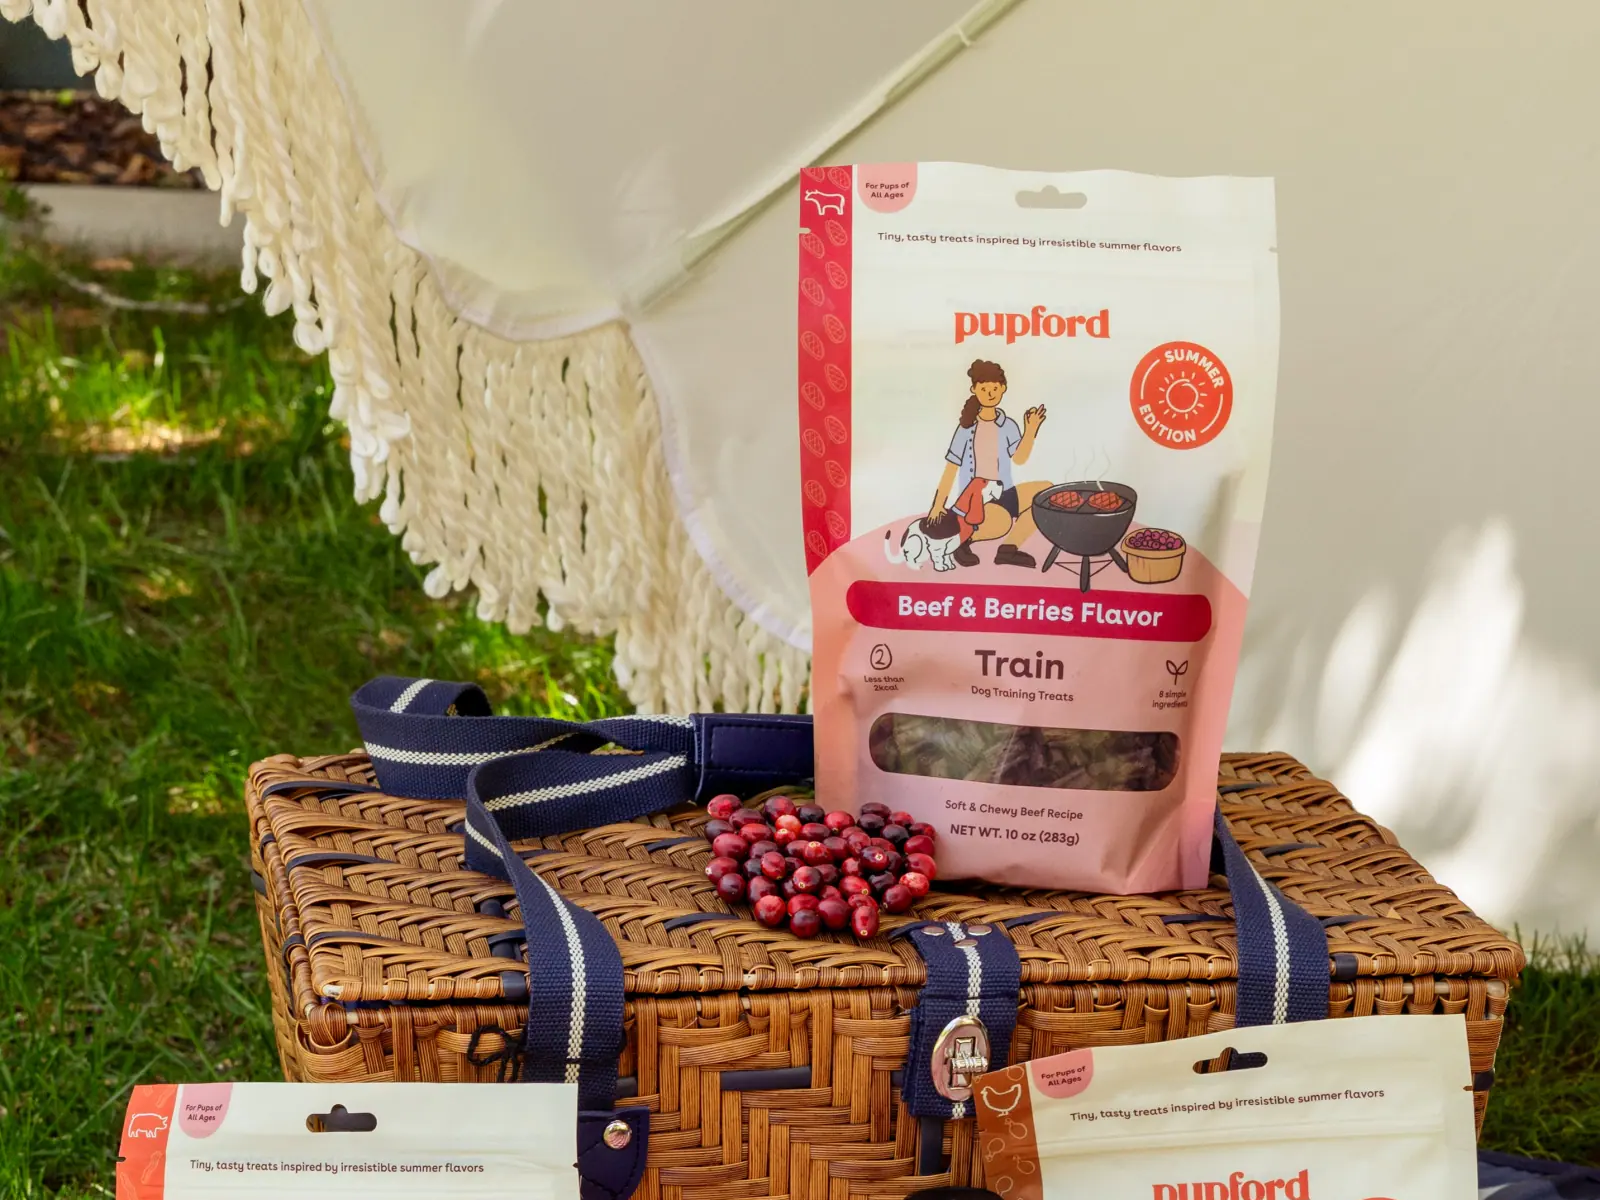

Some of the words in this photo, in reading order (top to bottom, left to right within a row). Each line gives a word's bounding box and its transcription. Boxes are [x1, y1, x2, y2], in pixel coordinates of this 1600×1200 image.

[878, 232, 904, 242] Tiny,
[907, 234, 936, 243] tasty
[940, 234, 973, 242] treats
[976, 235, 1019, 245] inspired
[1023, 237, 1036, 247] by
[1039, 238, 1096, 248] irresistible
[1099, 242, 1140, 250] summer
[1143, 242, 1181, 252] flavors
[955, 305, 1110, 345] pupford
[1165, 349, 1224, 388] SUMMER
[1139, 404, 1196, 442] EDITION
[898, 595, 954, 617] Beef
[959, 597, 977, 618] &
[984, 598, 1074, 622] Berries
[1081, 602, 1163, 627] Flavor
[974, 650, 1064, 679] Train
[971, 685, 991, 698] Dog
[993, 687, 1036, 701] Training
[1038, 691, 1074, 702] Treats
[1166, 690, 1186, 700] simple
[945, 800, 966, 811] Soft
[969, 802, 976, 812] &
[980, 804, 1017, 817] Chewy
[1021, 807, 1044, 817] Beef
[1048, 809, 1083, 821] Recipe
[950, 824, 976, 836] NET
[978, 827, 1002, 838] WT.
[1005, 829, 1018, 839] 10
[1021, 832, 1036, 841] oz
[1039, 830, 1079, 846] (283g)
[1056, 1070, 1075, 1078] Pups
[1061, 1076, 1082, 1084] Ages
[1070, 1112, 1098, 1121] Tiny,
[1100, 1110, 1130, 1119] tasty
[1134, 1107, 1168, 1116] treats
[1171, 1102, 1215, 1113] inspired
[1219, 1101, 1232, 1110] by
[1236, 1096, 1295, 1107] irresistible
[1298, 1093, 1342, 1103] summer
[1344, 1089, 1384, 1099] flavors
[199, 1114, 216, 1122] Ages
[190, 1160, 214, 1172] Tiny,
[216, 1161, 244, 1172] tasty
[246, 1161, 277, 1171] treats
[281, 1162, 321, 1173] inspired
[325, 1163, 338, 1174] by
[341, 1163, 397, 1172] irresistible
[400, 1164, 442, 1172] summer
[445, 1163, 484, 1172] flavors
